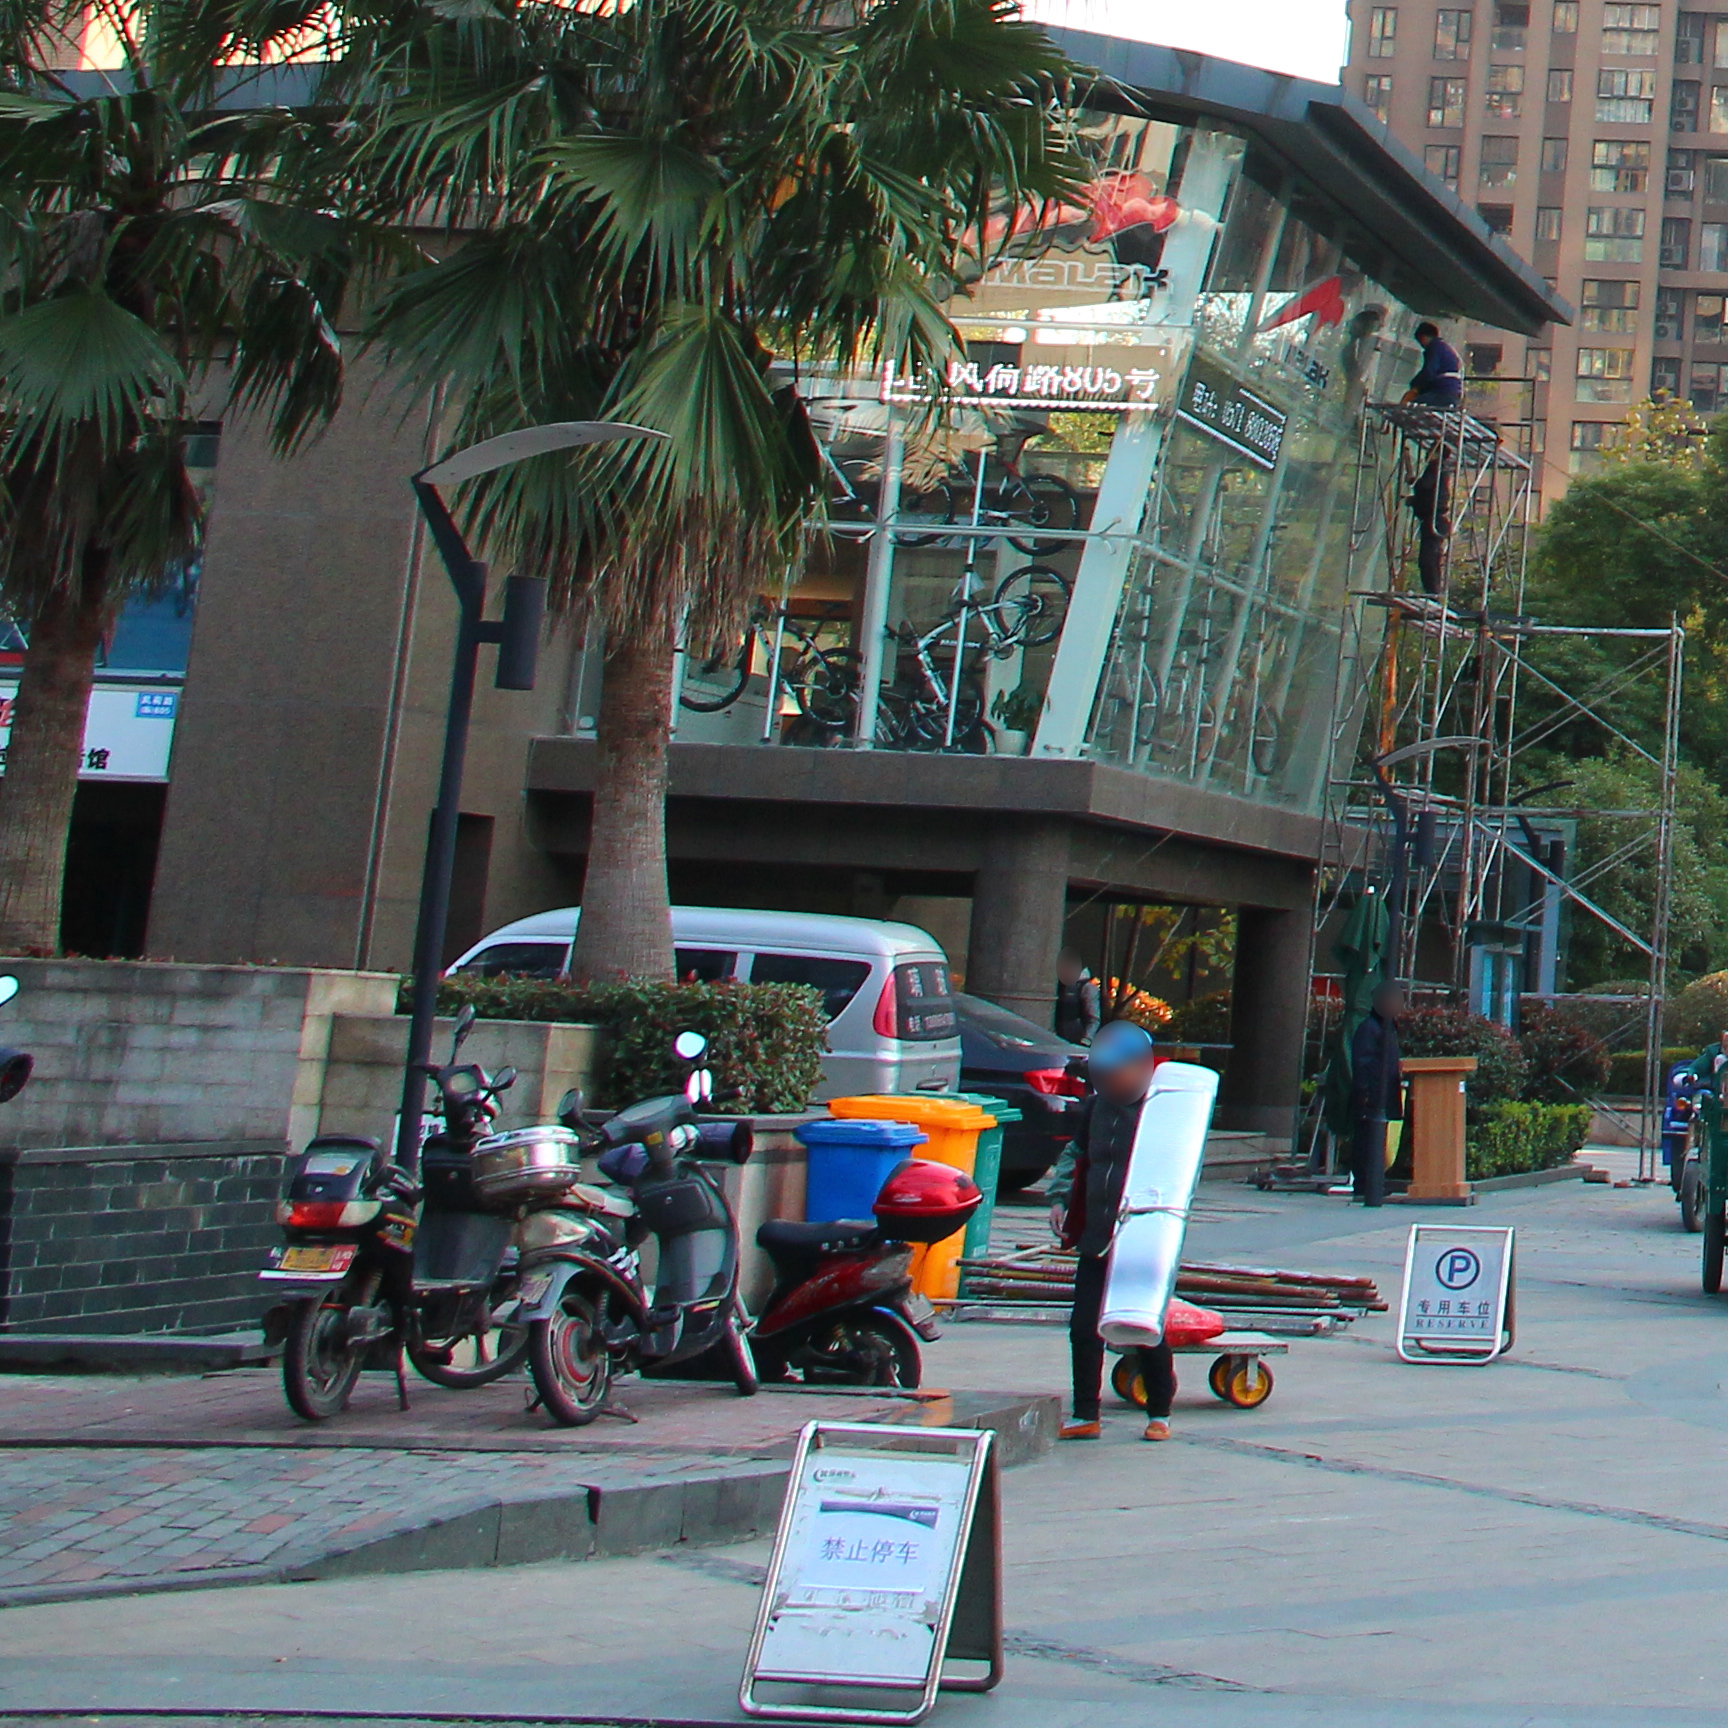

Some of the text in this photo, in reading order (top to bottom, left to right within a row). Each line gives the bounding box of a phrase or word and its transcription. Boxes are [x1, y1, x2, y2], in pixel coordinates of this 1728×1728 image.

[1418, 1298, 1491, 1315] 专用车位
[1415, 1318, 1490, 1329] RESERVE
[820, 1535, 921, 1566] 禁止停车
